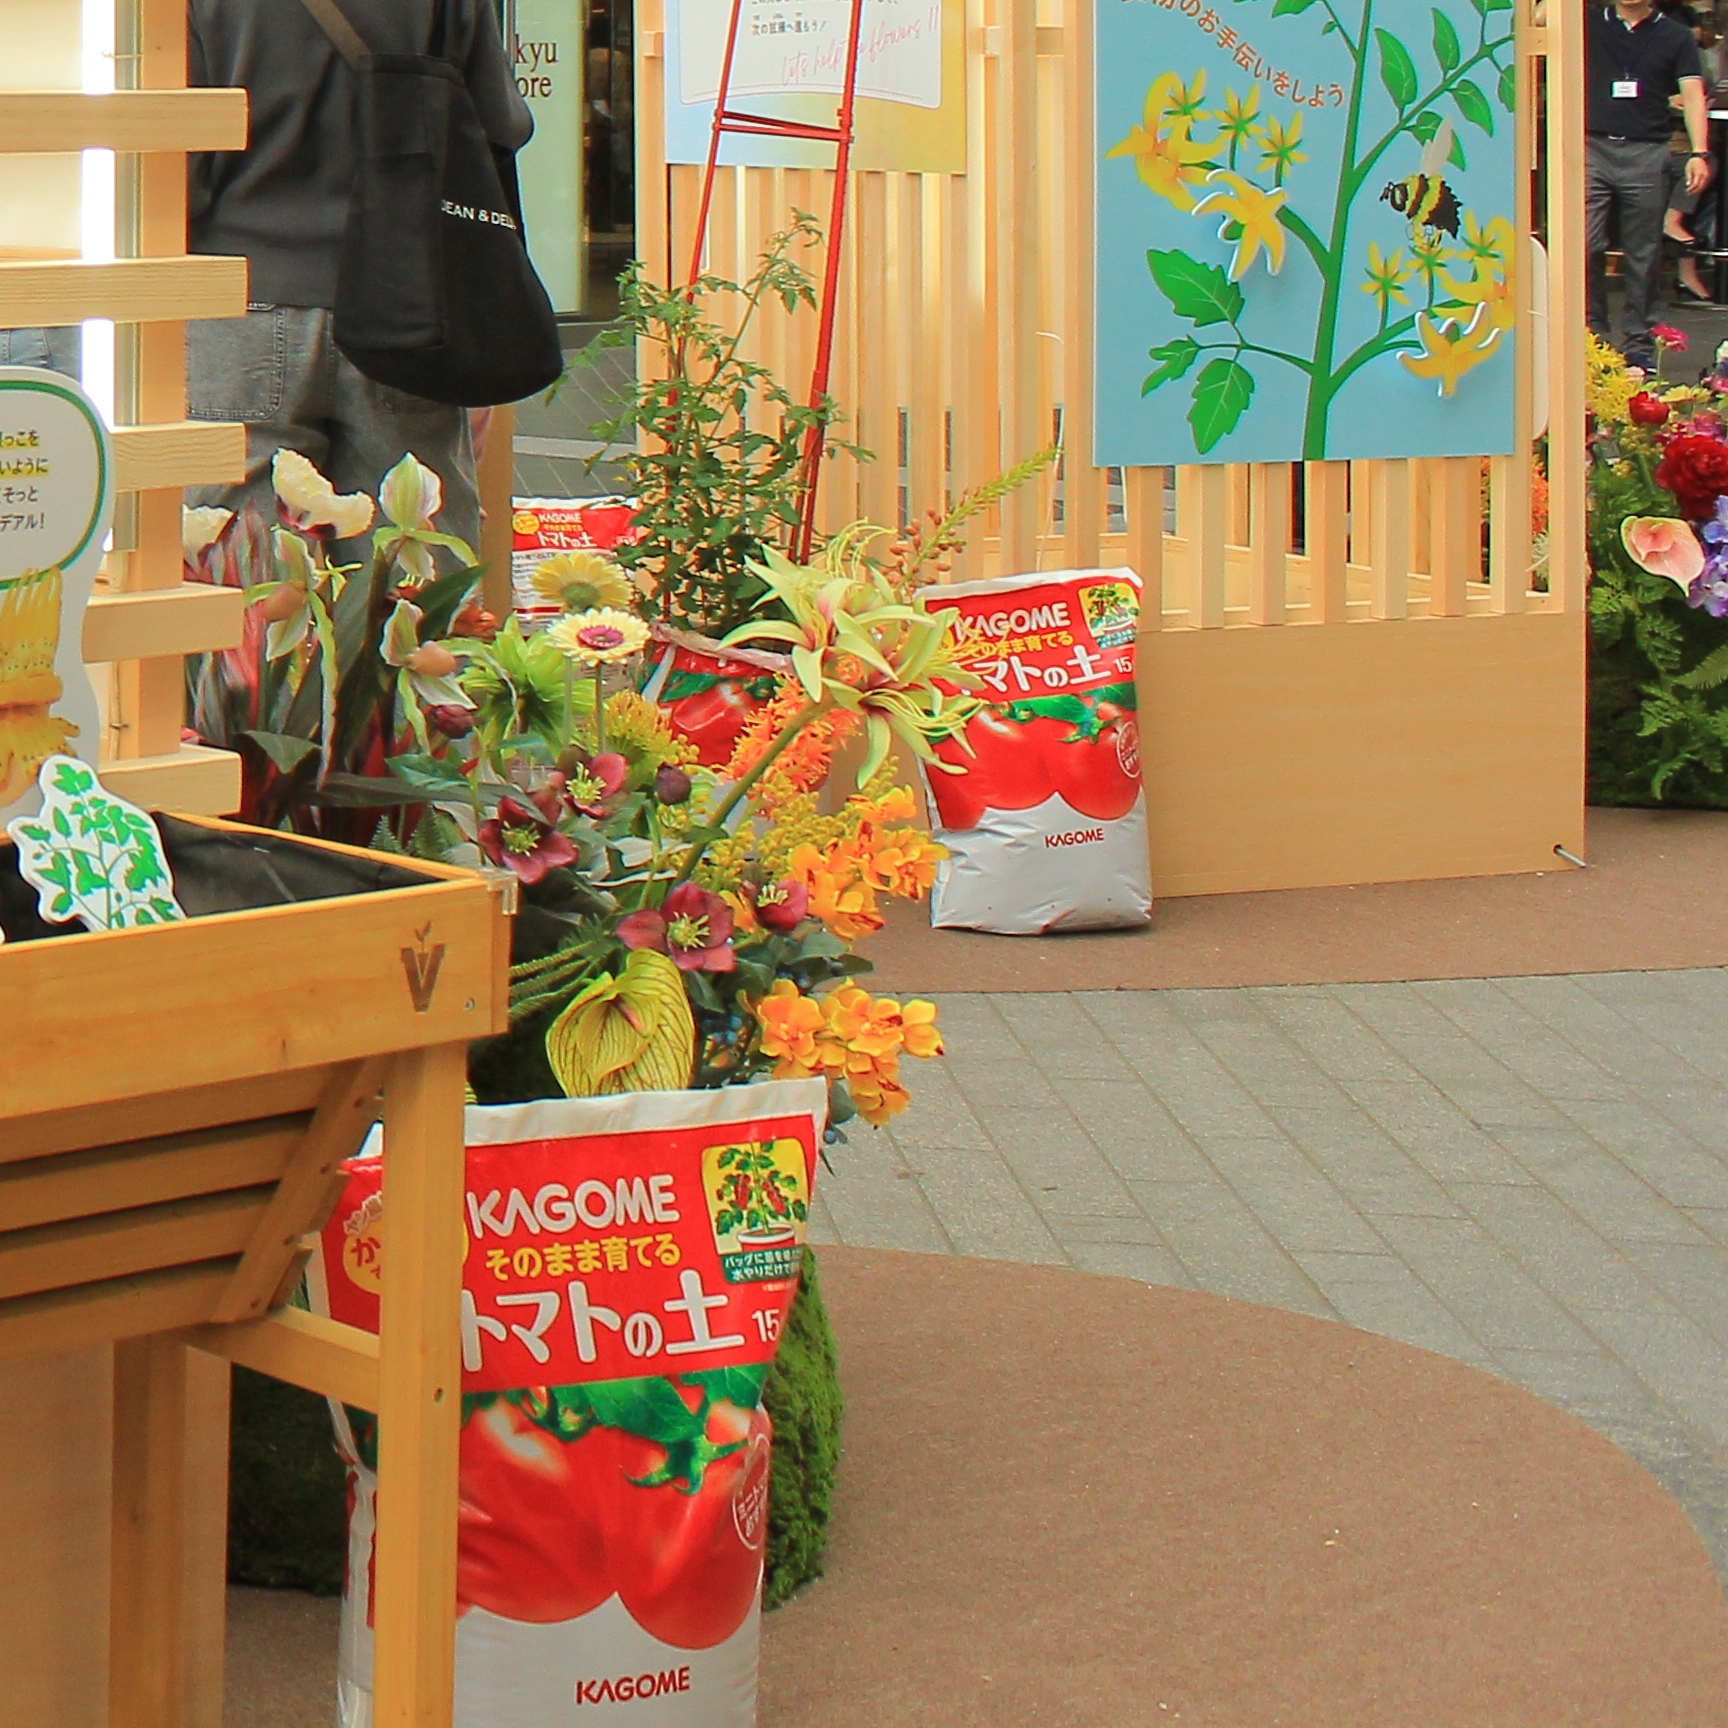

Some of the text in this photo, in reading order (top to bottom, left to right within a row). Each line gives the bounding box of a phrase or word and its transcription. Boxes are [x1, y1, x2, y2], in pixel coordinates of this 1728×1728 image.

[538, 512, 583, 524] KAGOME
[536, 530, 598, 548] トマトの土
[1044, 828, 1104, 849] KAGOME
[466, 1173, 680, 1240] KAGOME
[485, 1232, 681, 1282] そのまま育てる
[461, 1270, 745, 1372] トマトの土
[574, 1666, 691, 1706] KAGOME
